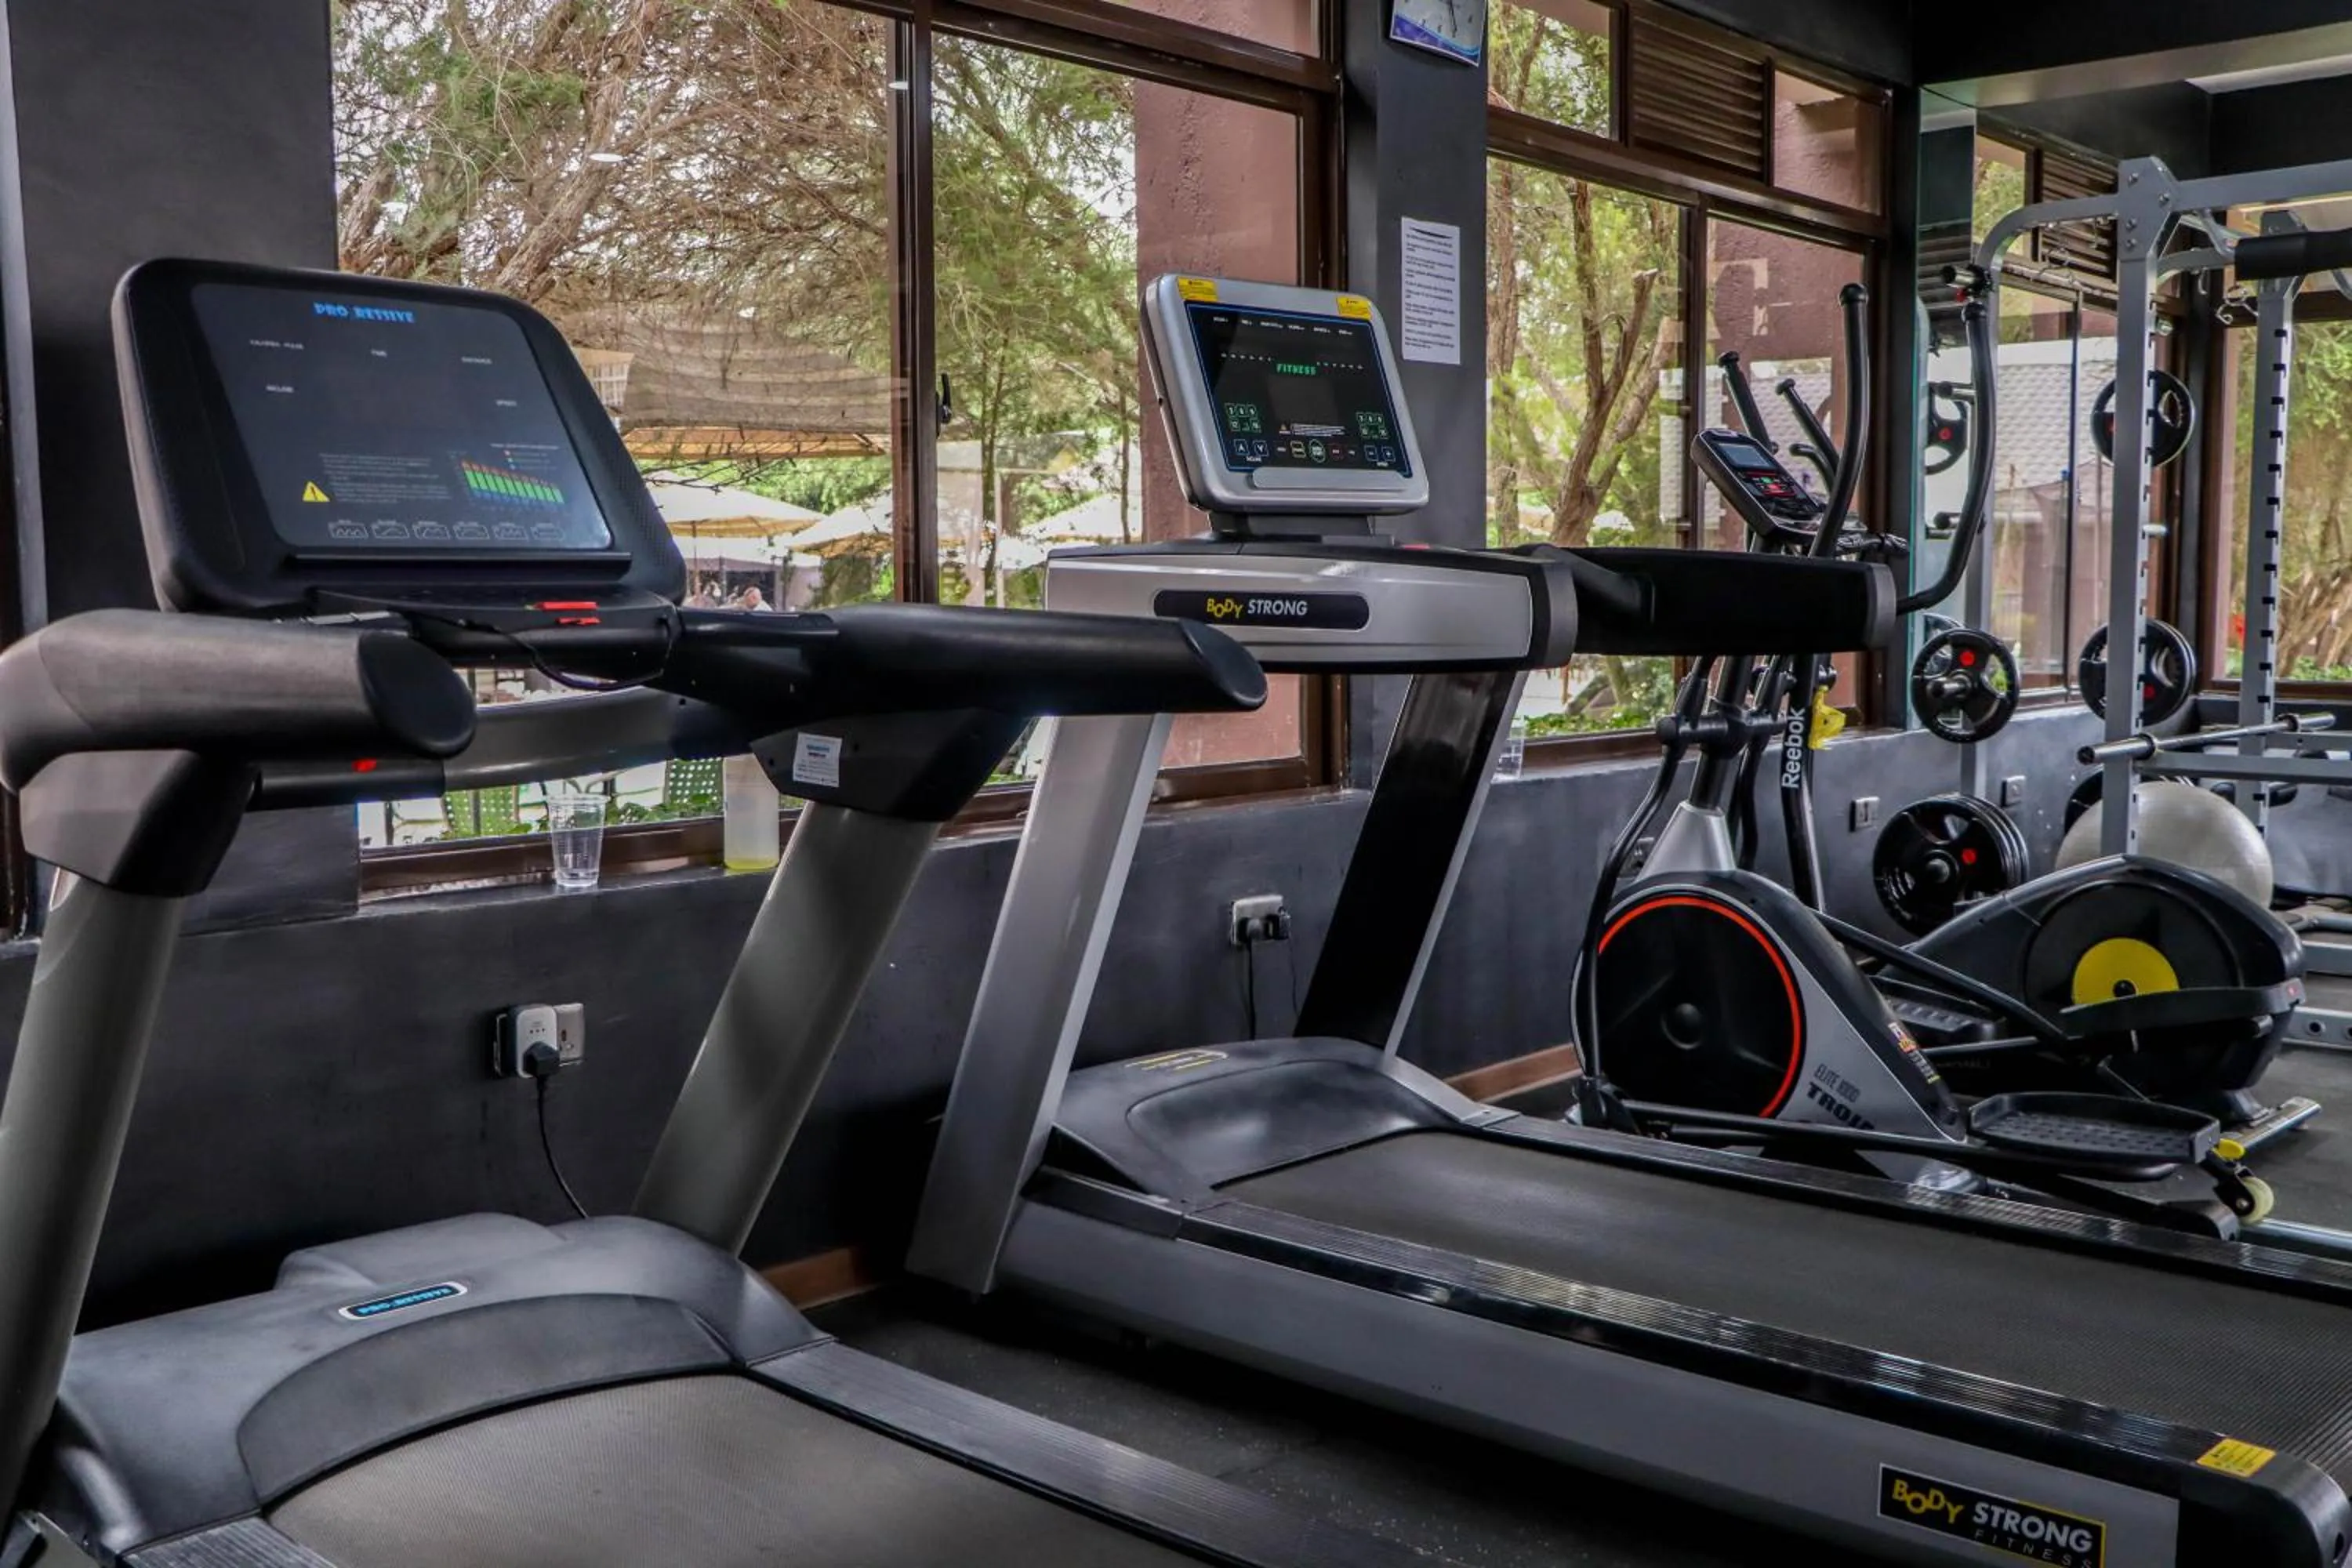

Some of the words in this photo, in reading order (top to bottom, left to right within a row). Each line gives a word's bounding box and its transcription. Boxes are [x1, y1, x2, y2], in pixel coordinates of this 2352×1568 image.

[1247, 599, 1308, 615] STRONG
[1781, 707, 1806, 789] Reebok
[1892, 1479, 1964, 1524] BODY
[1973, 1501, 2093, 1552] STRONG
[1974, 1530, 2092, 1568] FITNESS
